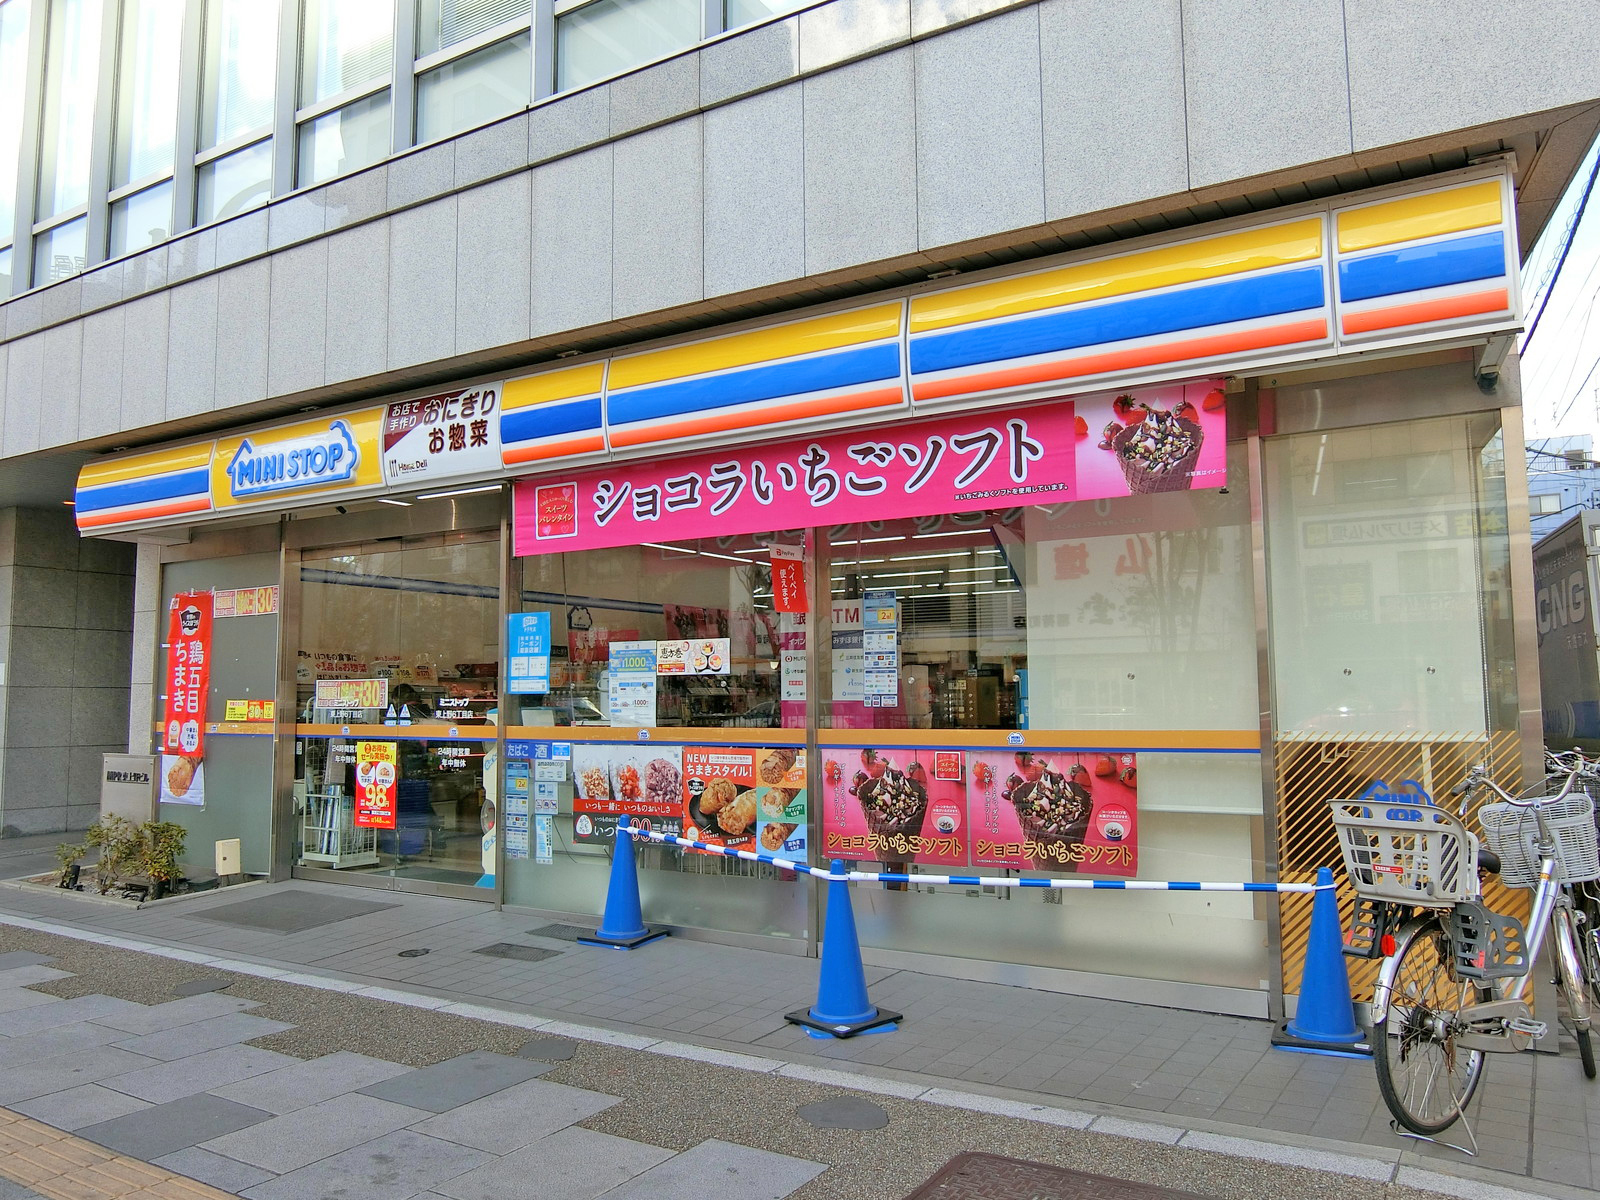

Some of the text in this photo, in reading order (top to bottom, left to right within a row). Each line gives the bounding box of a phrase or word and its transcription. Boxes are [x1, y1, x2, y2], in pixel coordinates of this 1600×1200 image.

[392, 402, 420, 417] お店で
[423, 389, 496, 425] おにぎり
[390, 415, 417, 430] 手作り
[428, 419, 488, 454] お惣菜
[238, 442, 343, 486] MINI STOP
[415, 459, 428, 468] Deli
[593, 418, 1044, 527] ショコラいちごソフト
[545, 504, 568, 514] スイーツ
[788, 563, 797, 598] ペイペイ
[1537, 570, 1585, 634] CNG
[832, 607, 859, 624] TM
[173, 639, 188, 712] ちまき
[187, 640, 204, 713] 鶏五目
[440, 698, 469, 707] ミニストップ
[332, 745, 357, 753] 24時間営
[508, 744, 529, 757] たばこ
[535, 744, 549, 758] 酒
[686, 754, 708, 763] NEW
[686, 764, 752, 777] ちまきスタイル!
[624, 803, 671, 813] いつものおいしさ
[827, 832, 962, 856] ショコラいちごソフト
[976, 839, 1133, 866] ショコラいちごソフト
